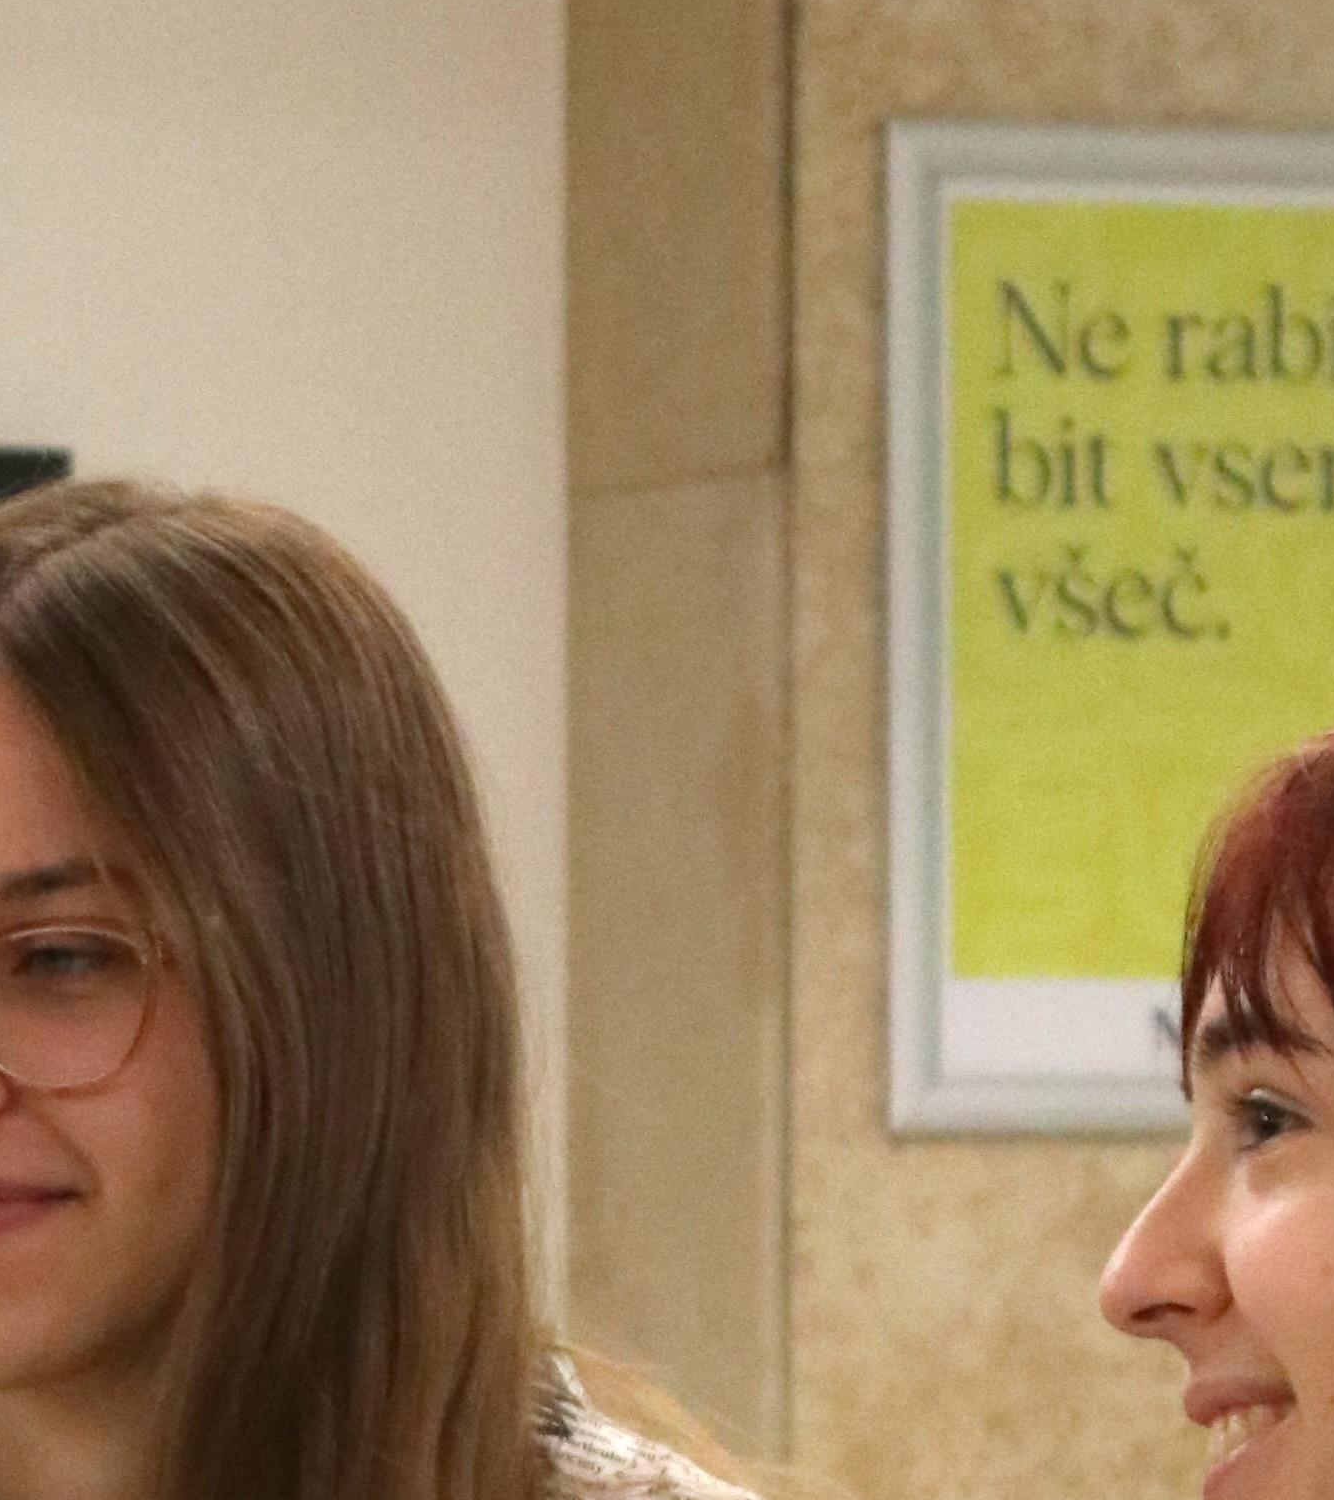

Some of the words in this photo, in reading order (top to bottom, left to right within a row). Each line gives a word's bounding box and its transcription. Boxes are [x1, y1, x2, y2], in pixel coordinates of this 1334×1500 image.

[996, 279, 1132, 382] Ne
[994, 406, 1109, 508] bit
[996, 545, 1232, 640] všeč.
